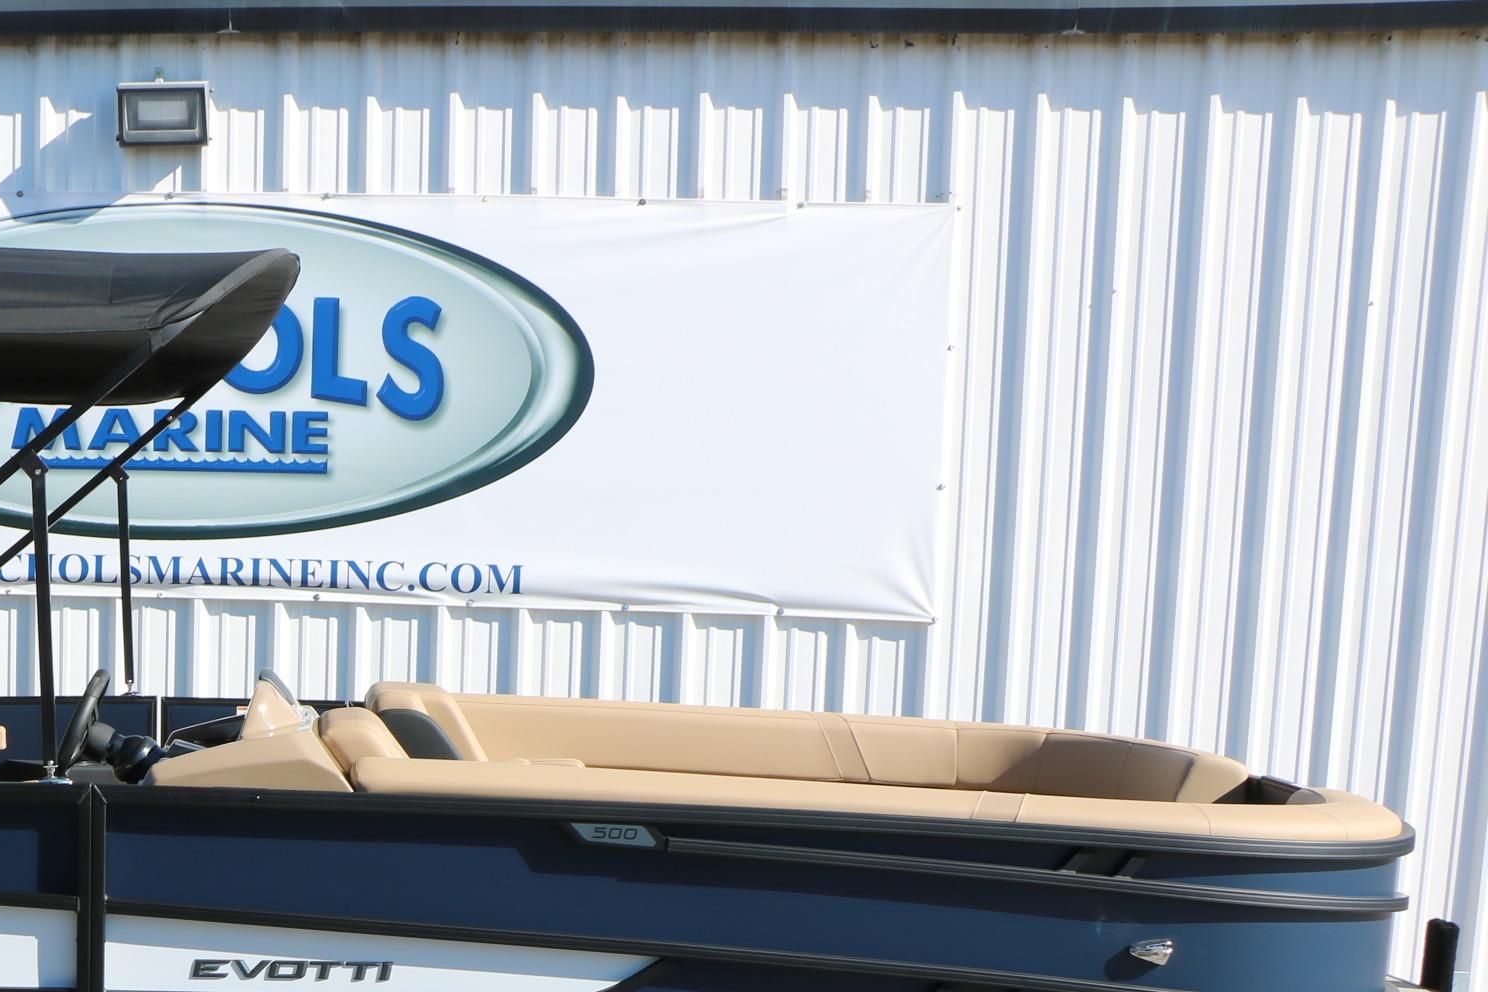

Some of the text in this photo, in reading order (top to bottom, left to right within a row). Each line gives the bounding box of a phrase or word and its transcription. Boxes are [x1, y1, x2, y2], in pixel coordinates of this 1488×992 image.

[11, 406, 330, 455] MARINE
[591, 826, 638, 841] 500
[189, 959, 394, 983] EVOTTI
